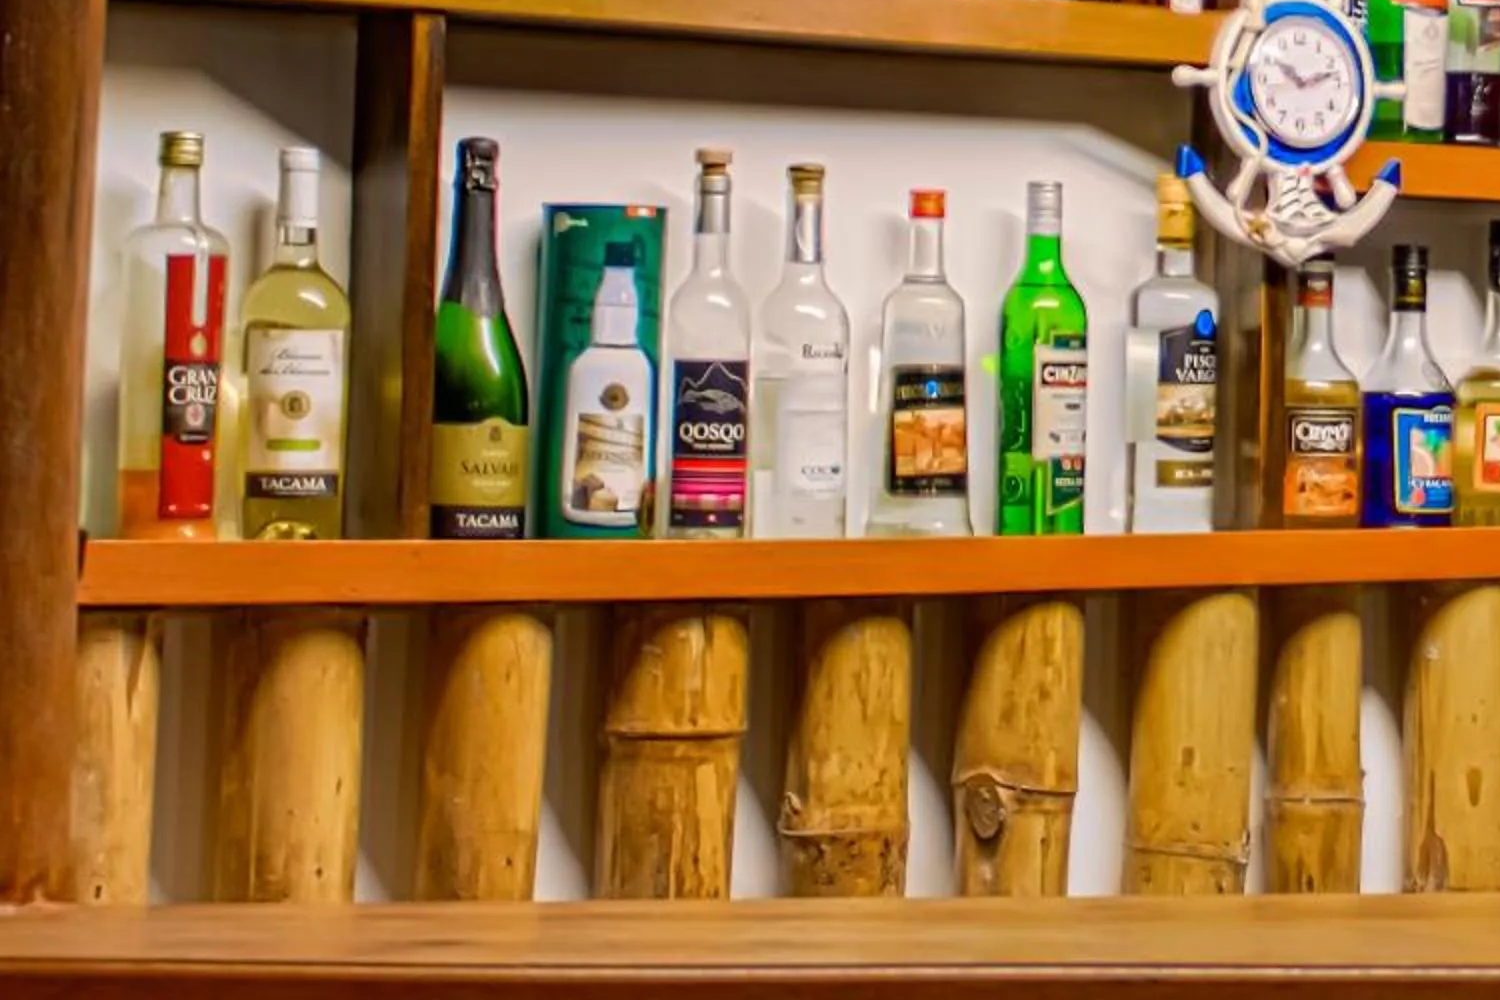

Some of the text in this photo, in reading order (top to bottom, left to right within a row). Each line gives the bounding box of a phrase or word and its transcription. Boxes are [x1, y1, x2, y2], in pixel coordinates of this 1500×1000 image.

[167, 365, 218, 386] GRAN
[167, 385, 217, 405] CRUZ
[260, 477, 328, 491] TACAMA
[455, 512, 519, 530] TACAMA
